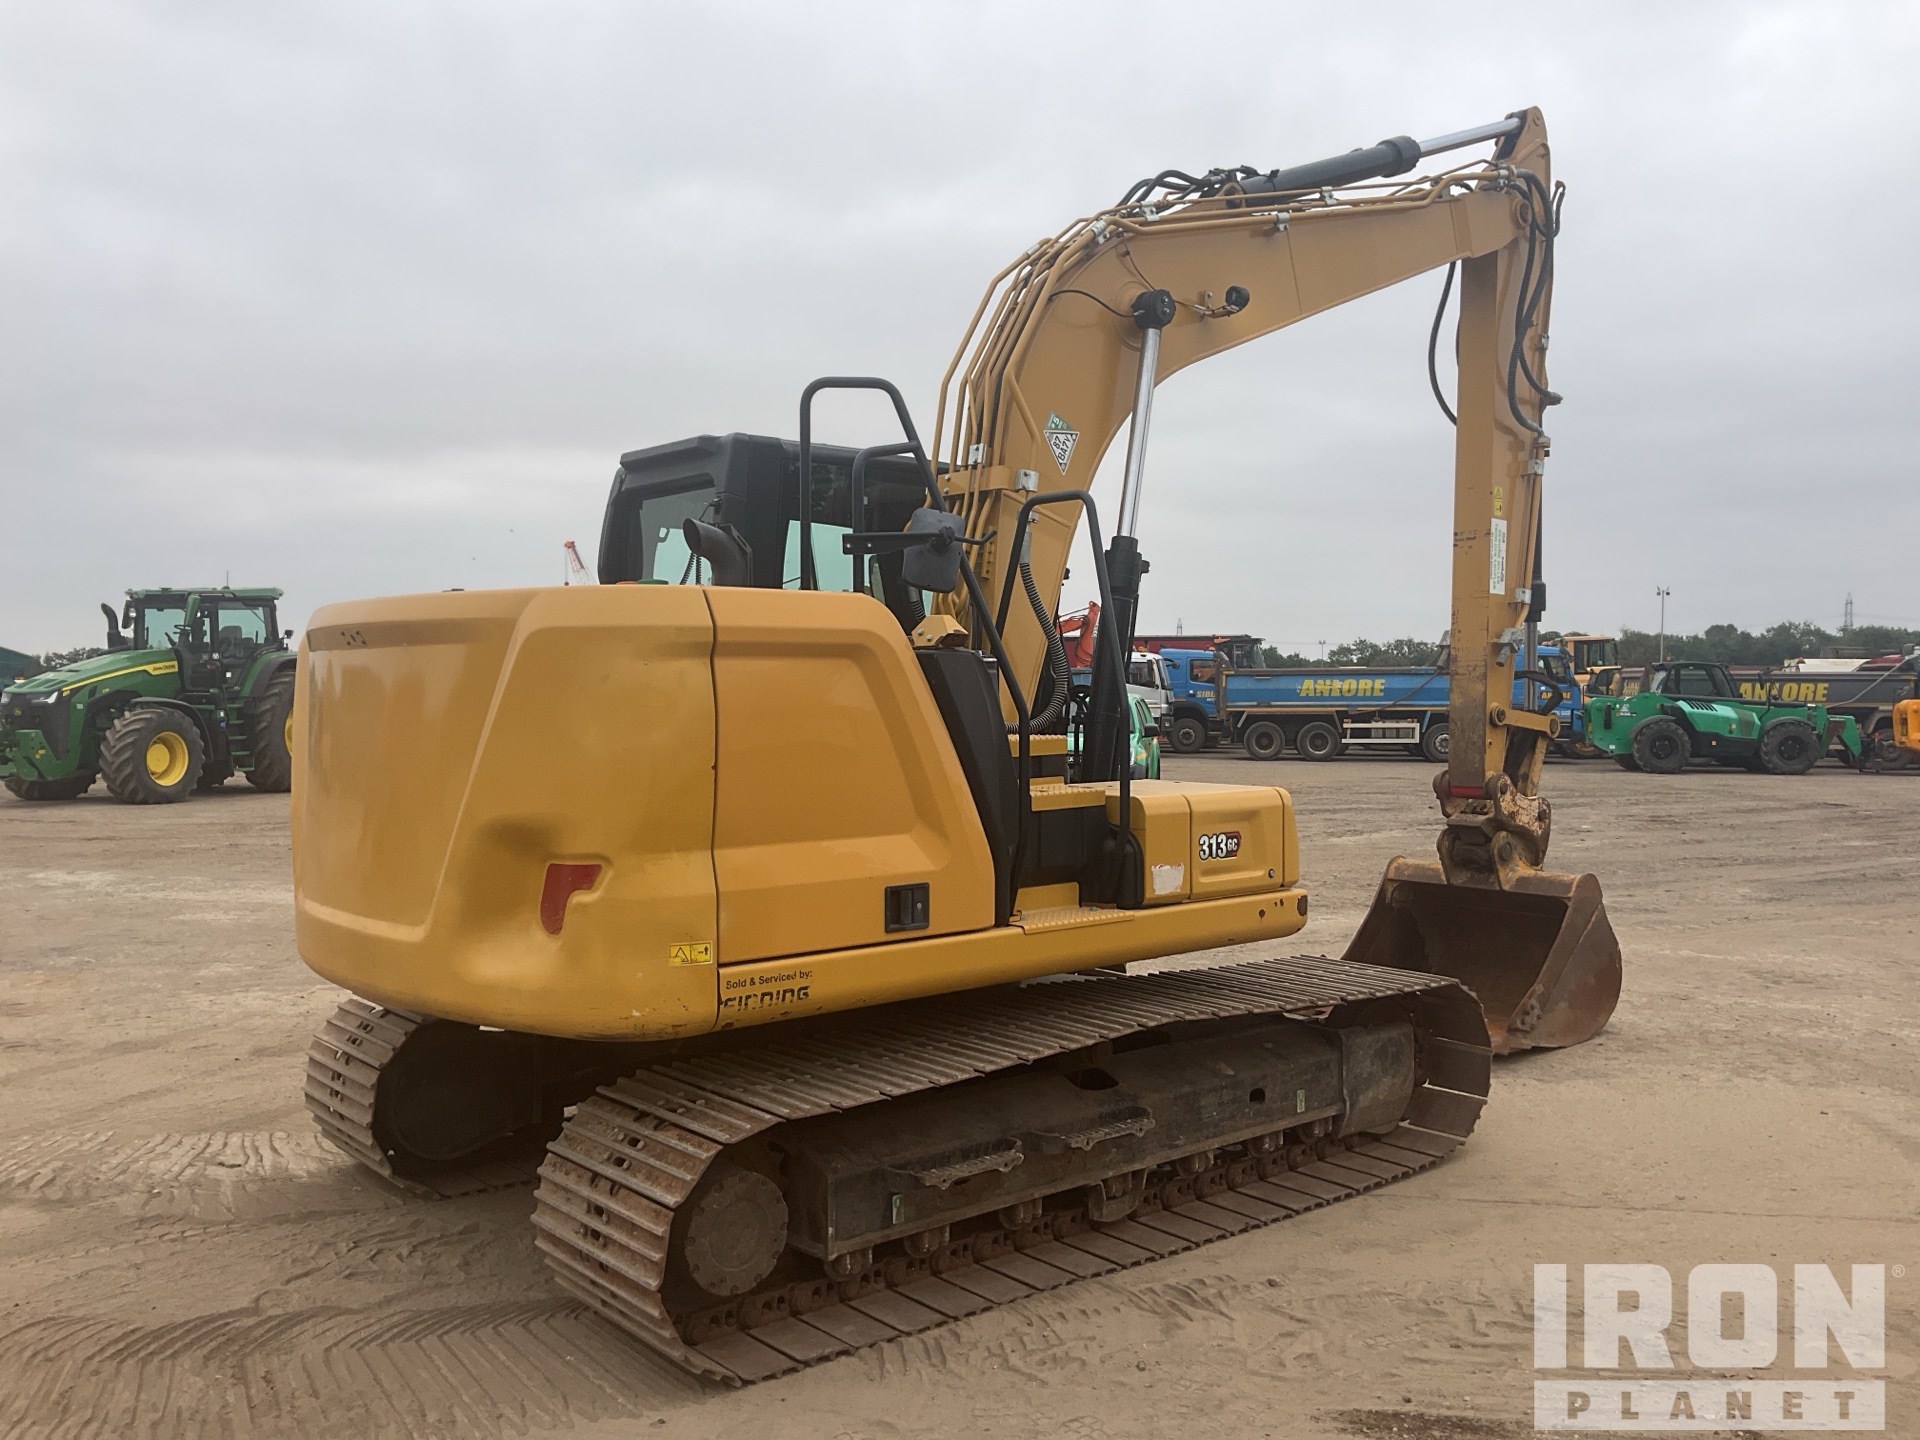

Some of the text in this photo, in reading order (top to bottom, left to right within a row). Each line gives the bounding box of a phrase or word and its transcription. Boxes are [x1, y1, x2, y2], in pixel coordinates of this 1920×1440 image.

[1199, 833, 1238, 861] 313 GC
[725, 969, 813, 990] Sold & Serviced by:
